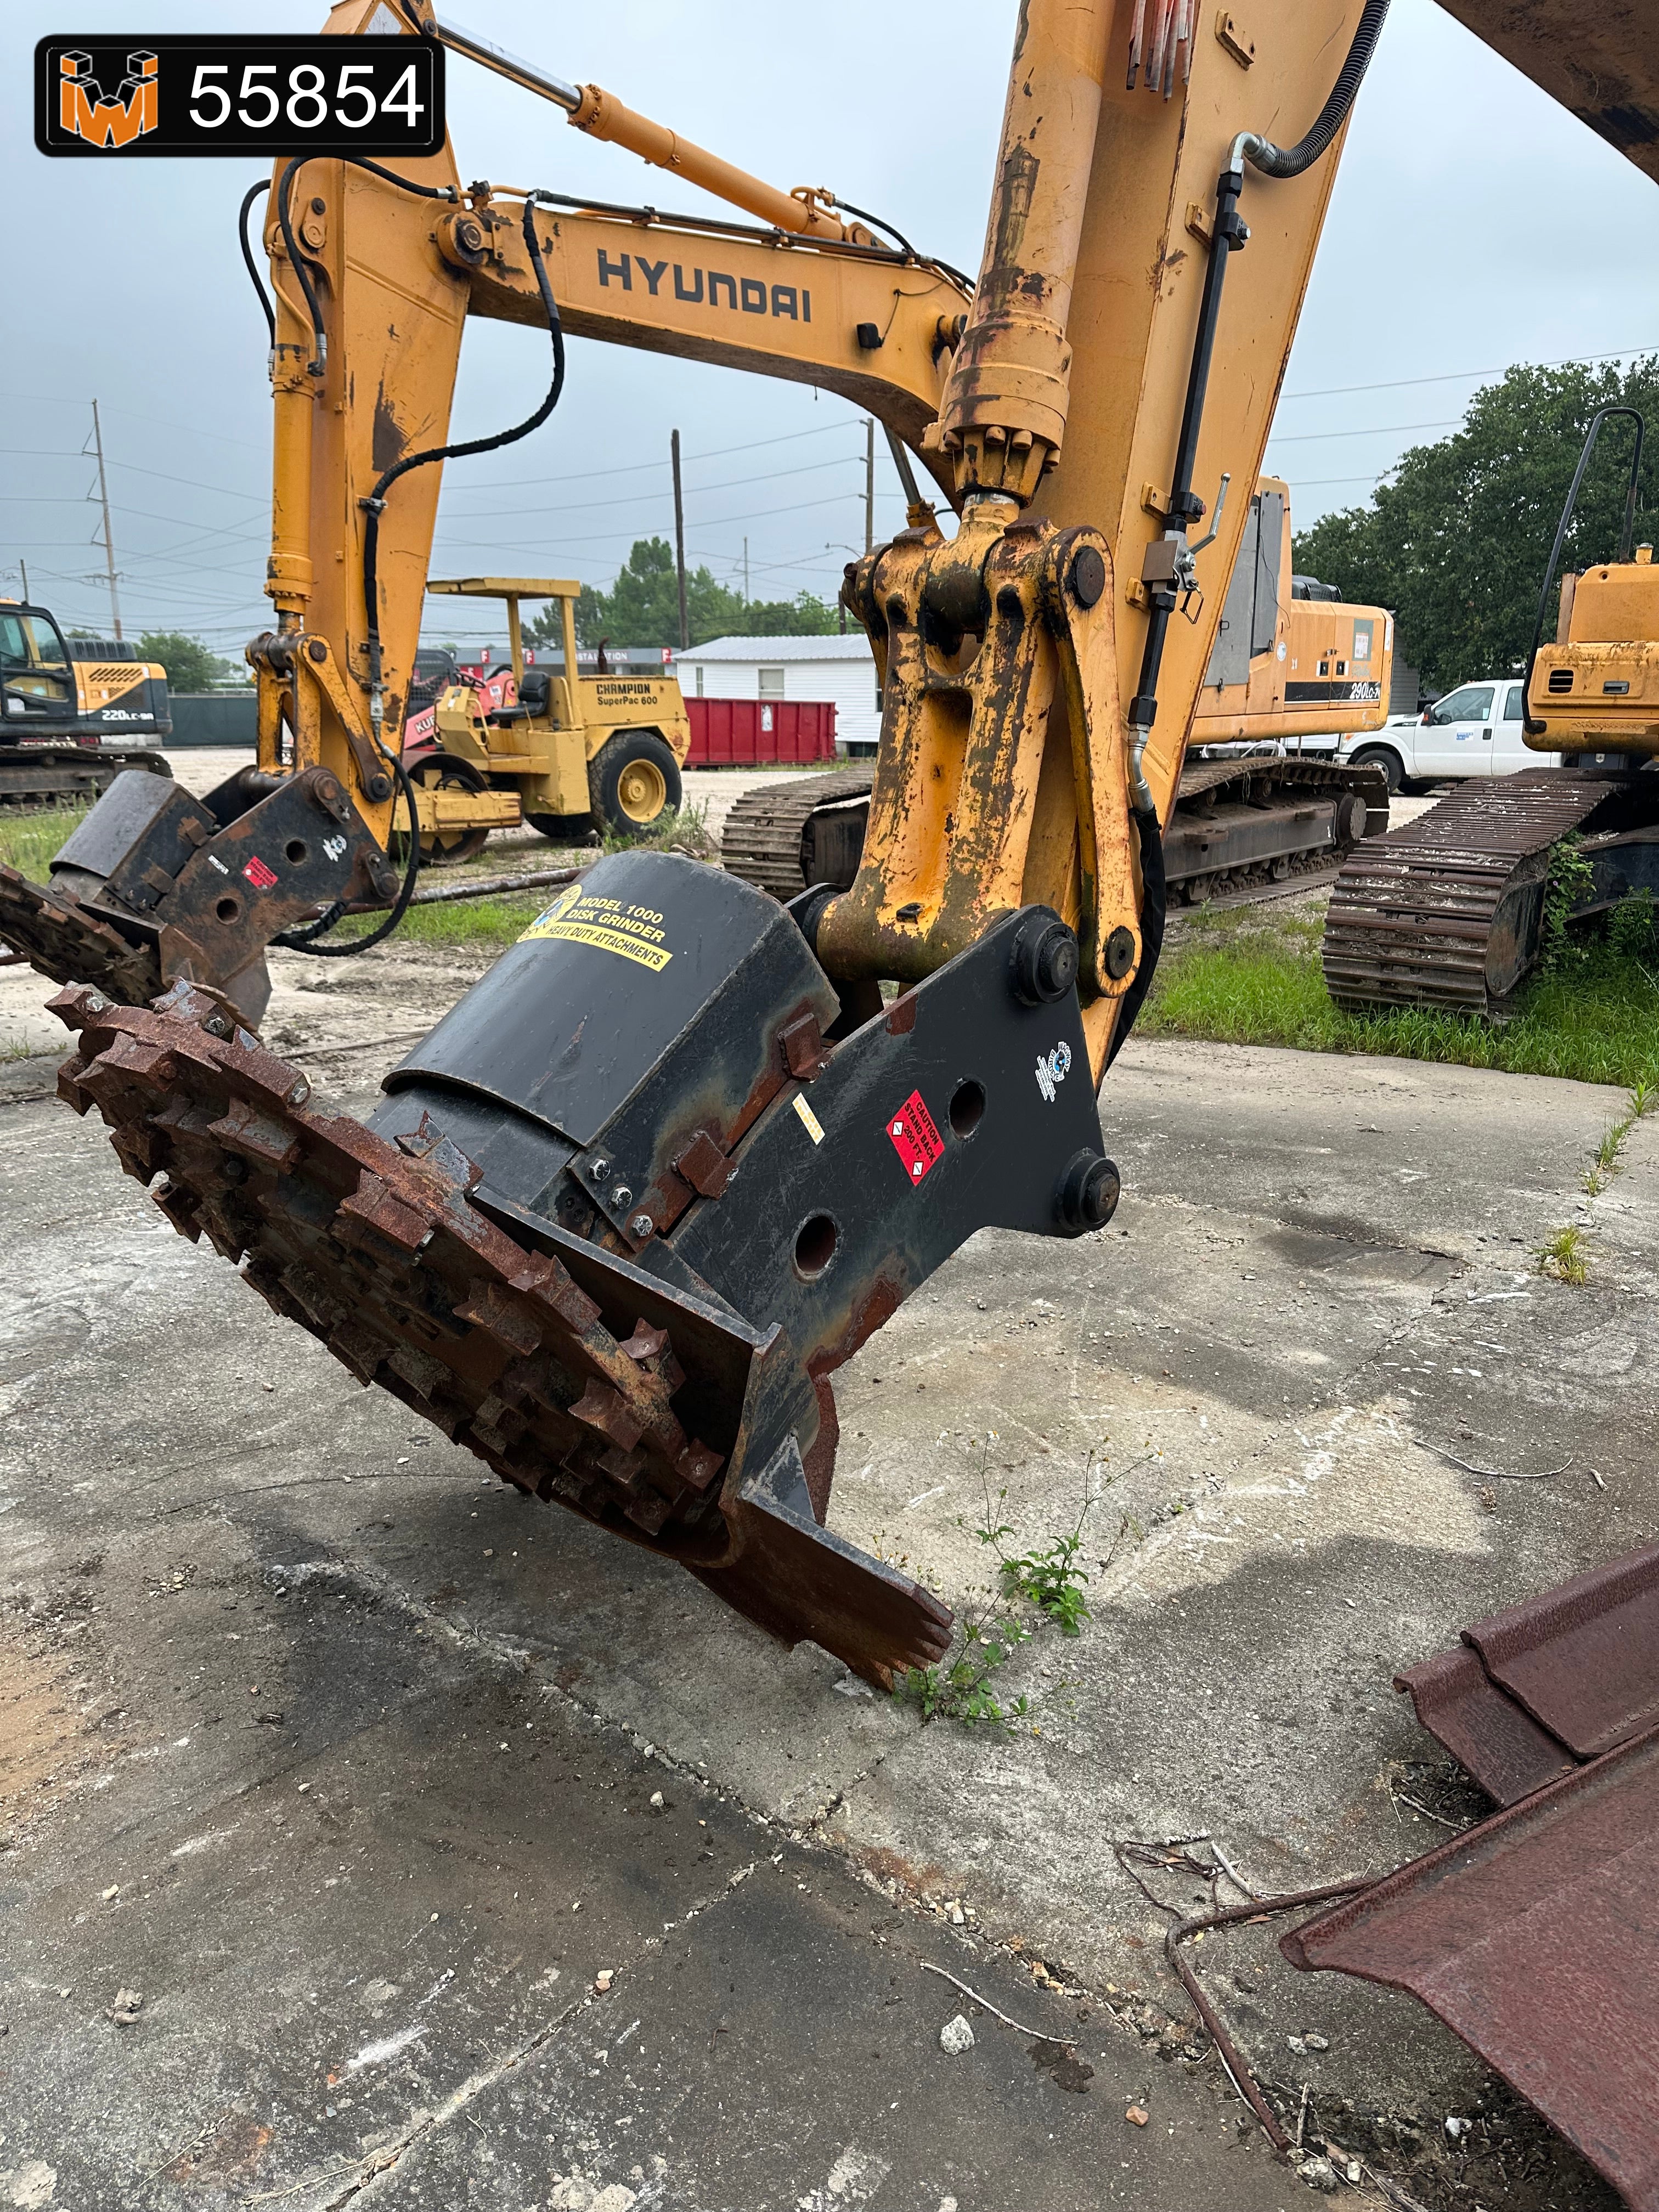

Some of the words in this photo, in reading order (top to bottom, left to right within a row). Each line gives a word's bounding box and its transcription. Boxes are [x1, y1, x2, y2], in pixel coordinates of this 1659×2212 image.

[597, 249, 811, 323] HYUNDAI
[596, 684, 651, 694] CHAMPION
[597, 696, 639, 707] SuperPac
[641, 696, 657, 705] 600
[566, 909, 599, 921] DISK
[598, 912, 665, 943] GRINDER
[577, 897, 622, 912] MODEL
[626, 905, 663, 924] 1000
[546, 926, 574, 936] HEAVY
[570, 927, 597, 940] DUTY
[592, 932, 664, 966] ATTACHMENTS
[905, 1103, 923, 1136] STAND
[920, 1133, 936, 1163] BACK
[916, 1102, 939, 1146] CAUTION
[904, 1125, 916, 1144] 200
[912, 1142, 922, 1159] FT.
